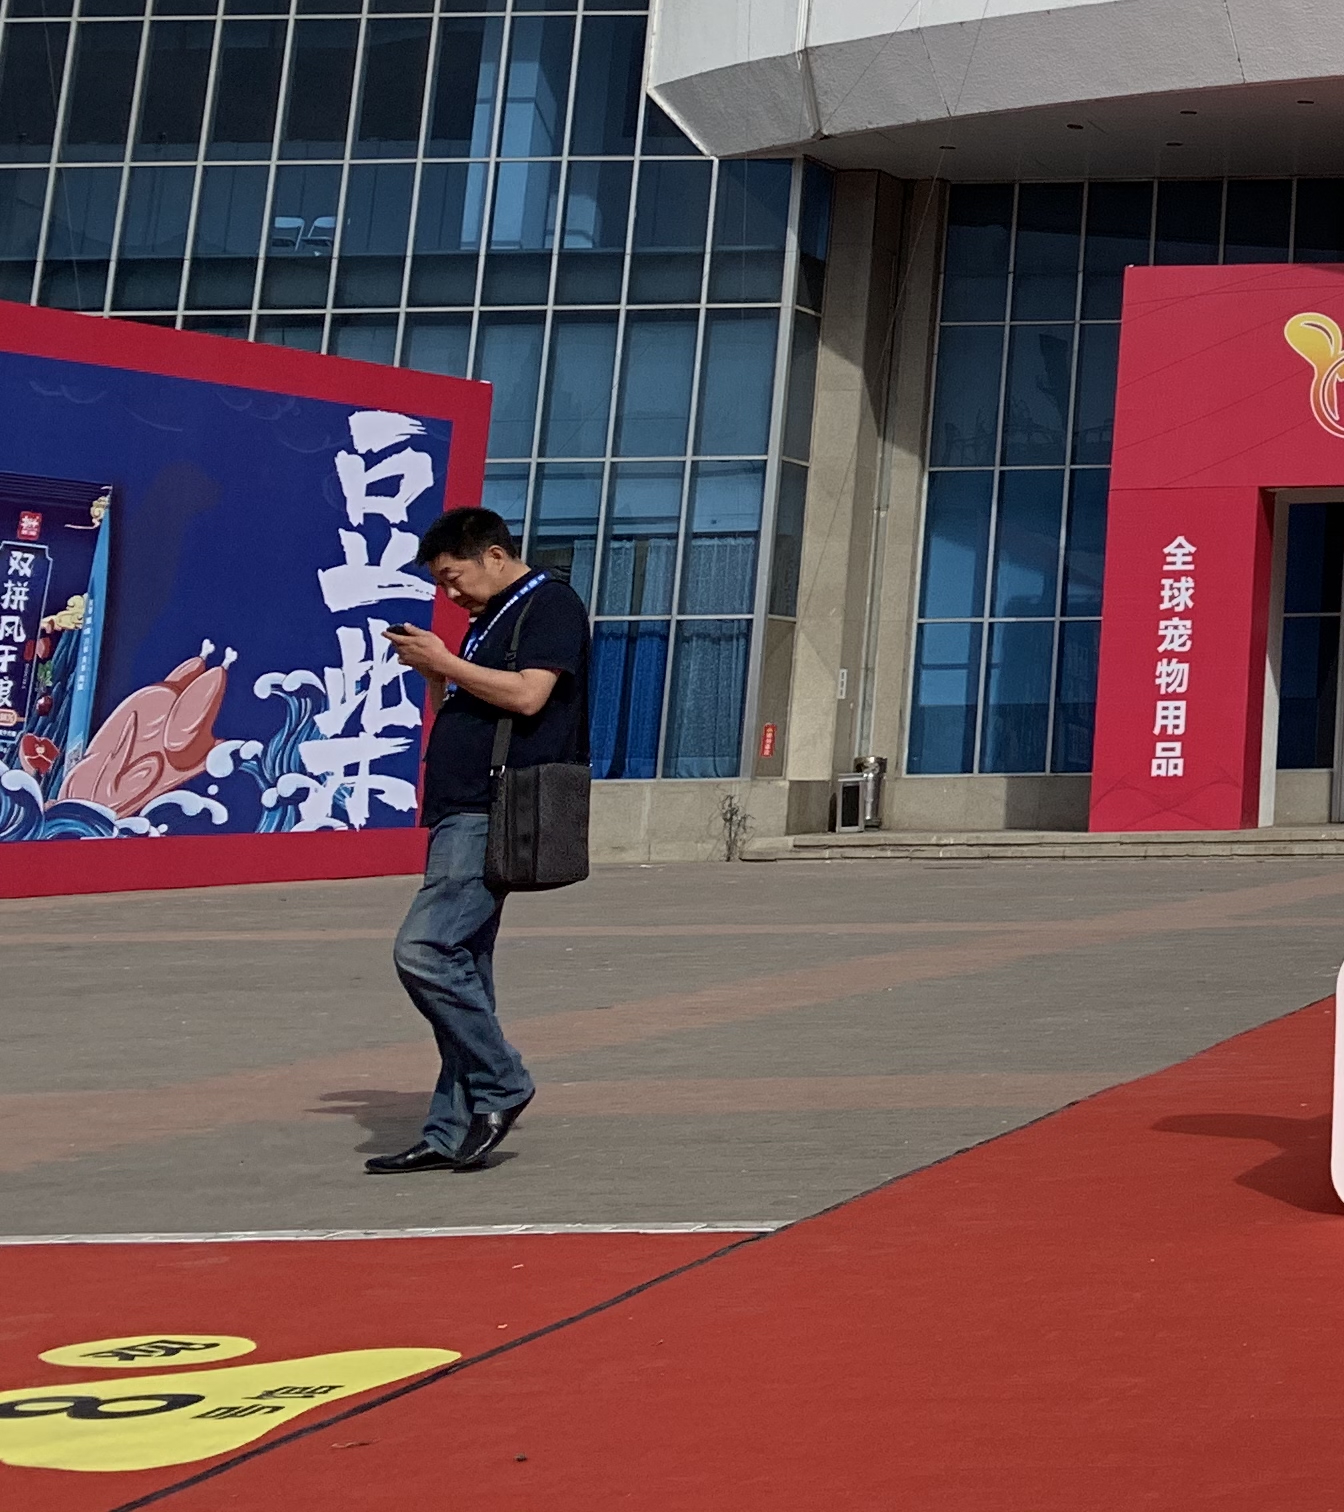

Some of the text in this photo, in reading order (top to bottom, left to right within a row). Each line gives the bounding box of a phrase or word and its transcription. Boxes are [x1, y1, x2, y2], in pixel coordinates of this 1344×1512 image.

[1151, 535, 1197, 778] 全球宠物用品
